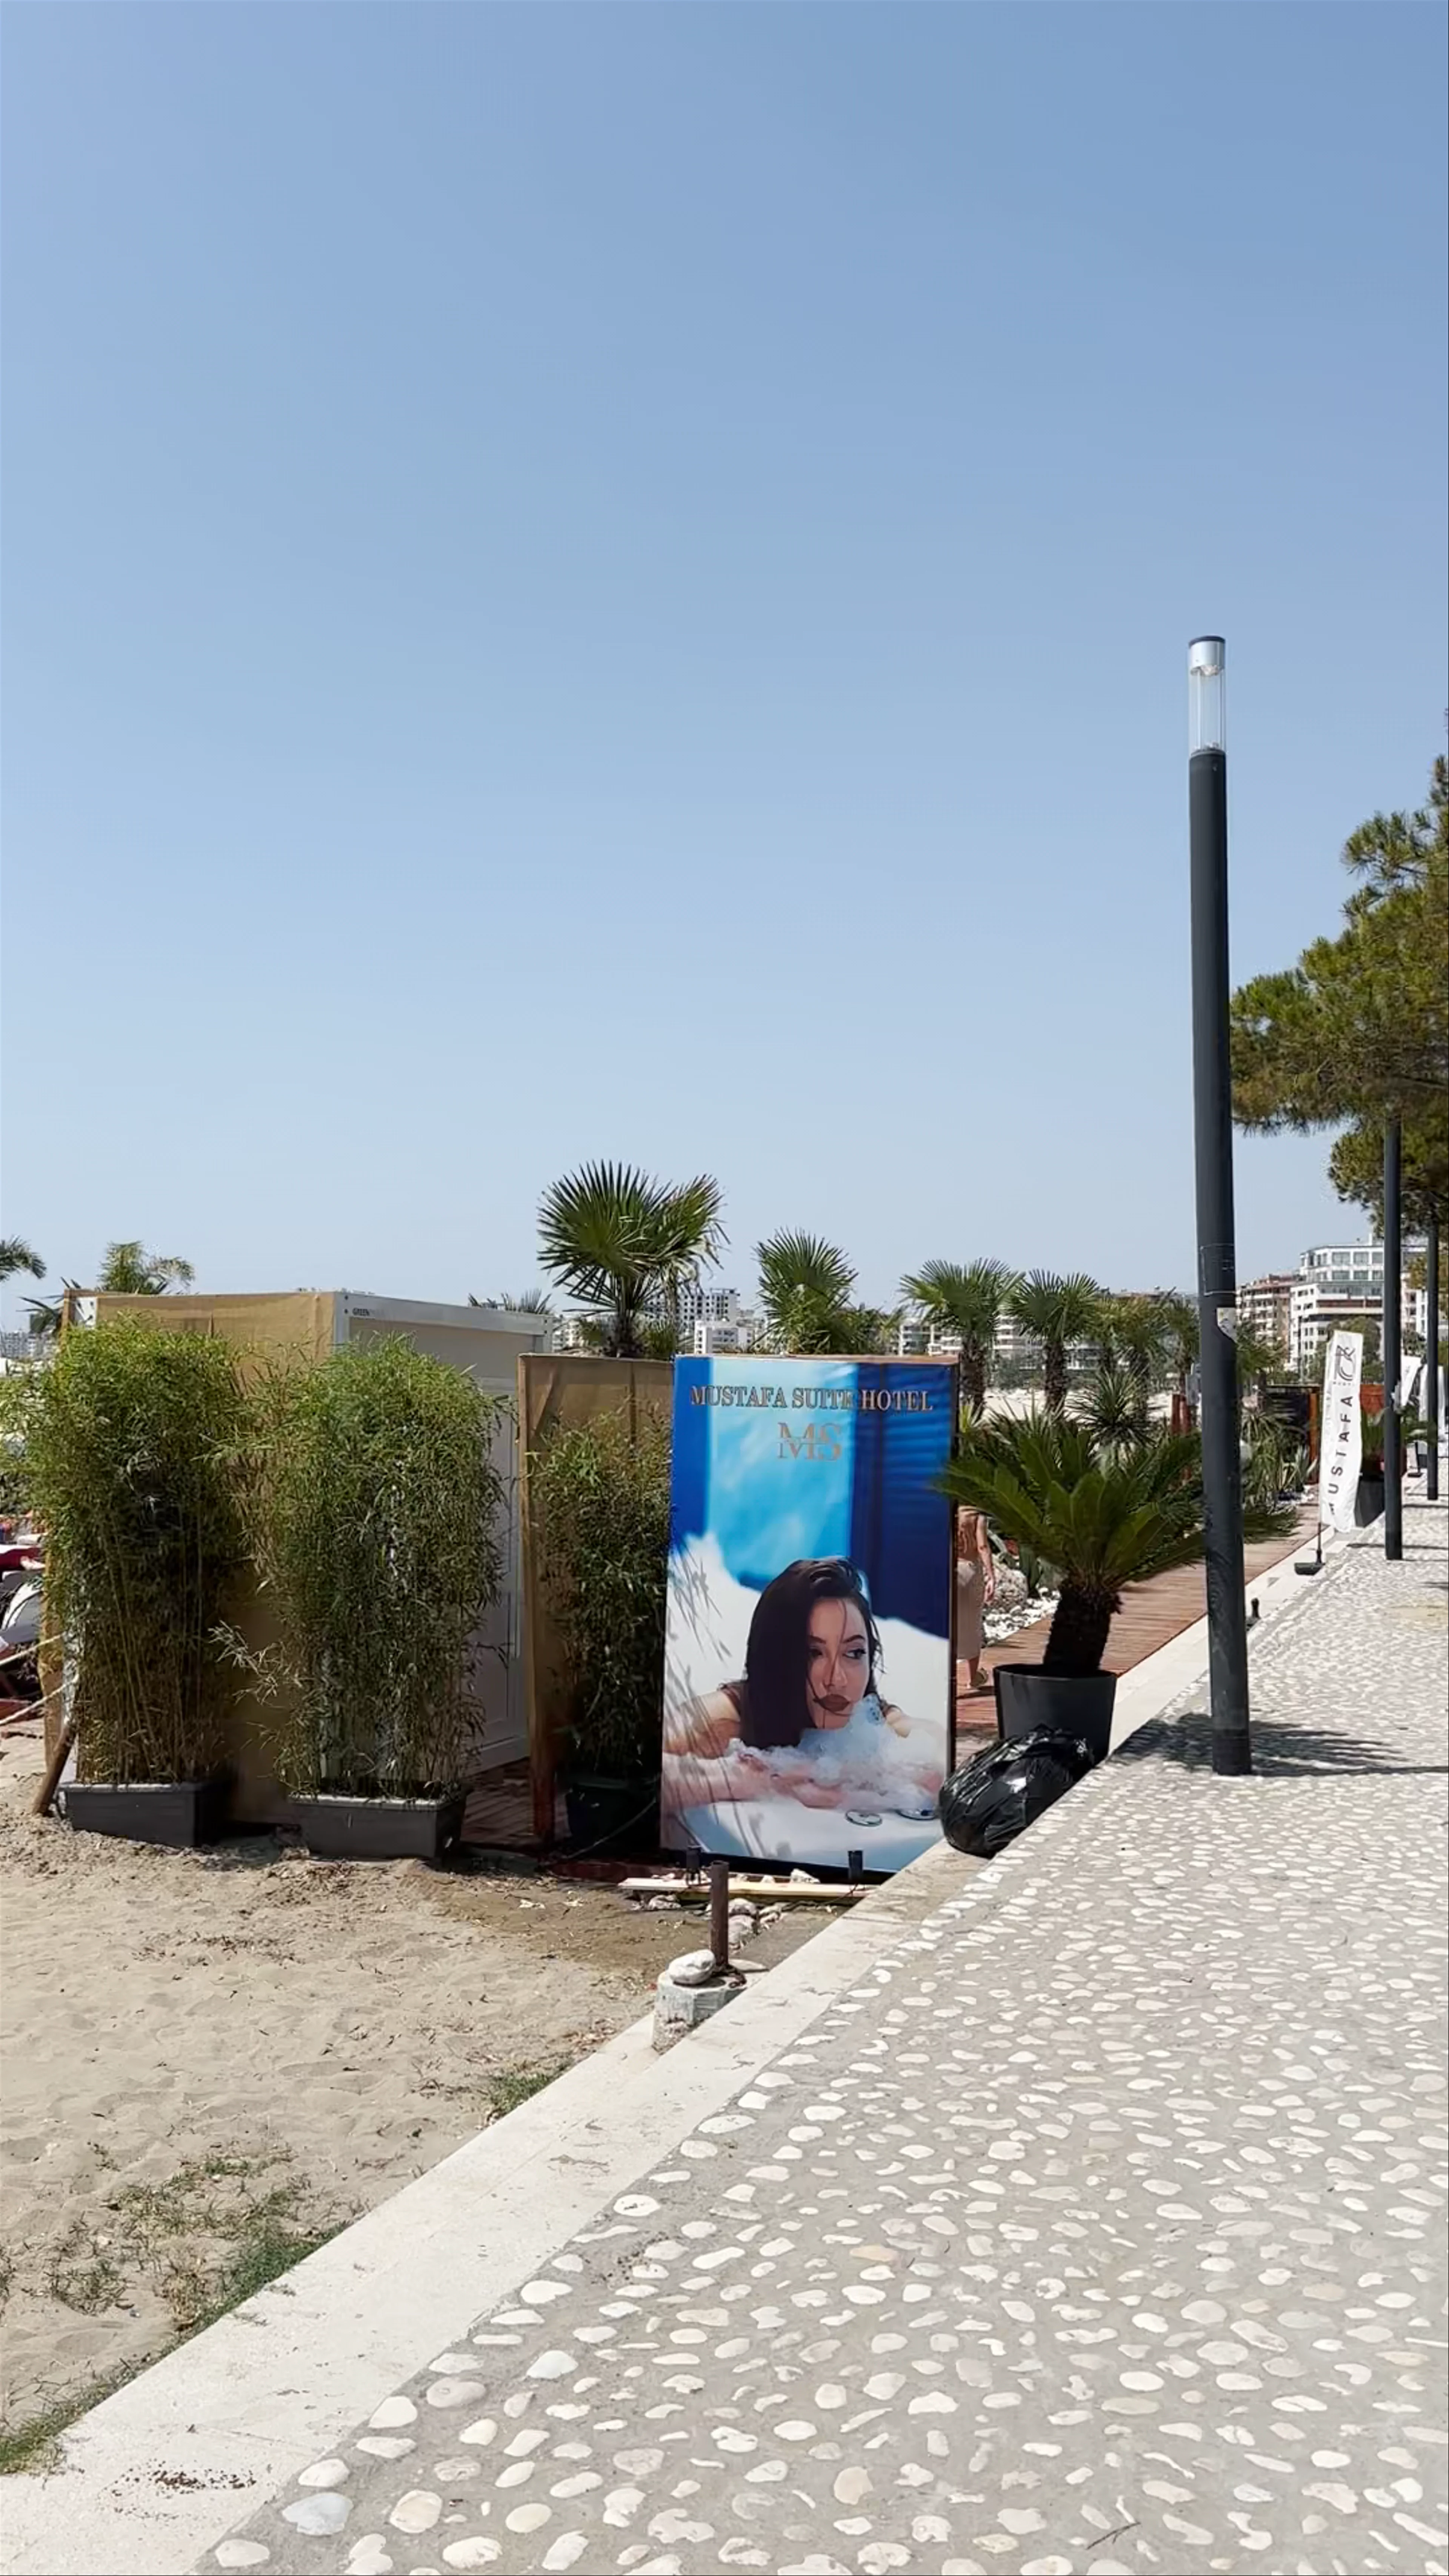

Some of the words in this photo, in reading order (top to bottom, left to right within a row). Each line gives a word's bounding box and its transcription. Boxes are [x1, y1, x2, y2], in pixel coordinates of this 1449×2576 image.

[691, 1385, 788, 1407] MUSTAFA
[792, 1387, 857, 1410] SUITE
[861, 1389, 934, 1411] HOTEL
[777, 1422, 842, 1461] MS
